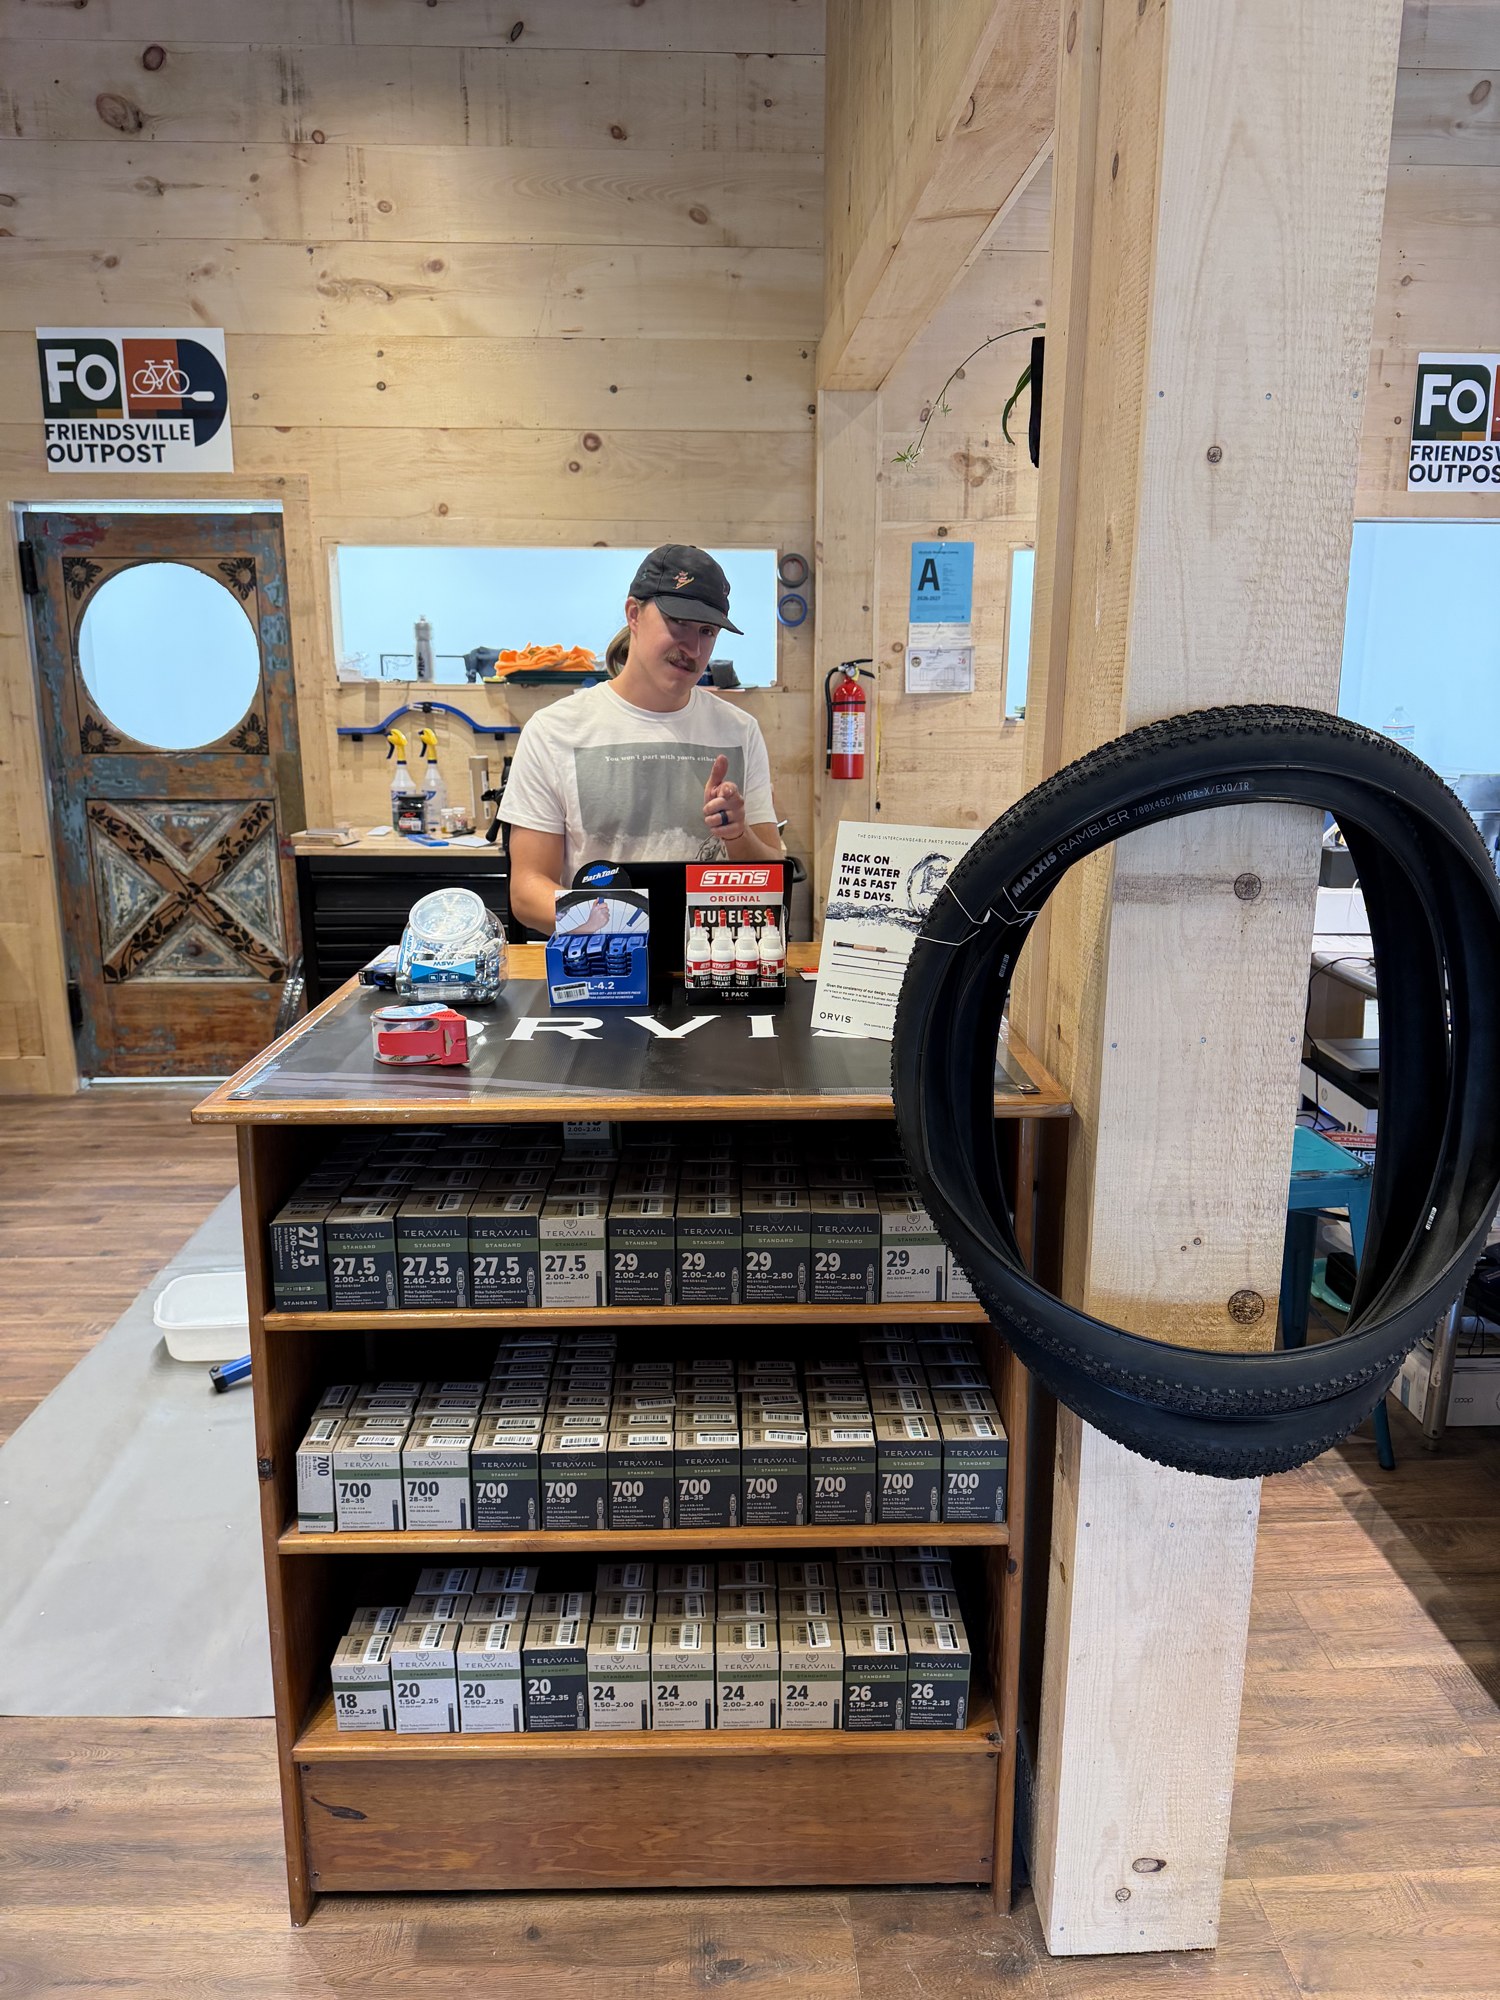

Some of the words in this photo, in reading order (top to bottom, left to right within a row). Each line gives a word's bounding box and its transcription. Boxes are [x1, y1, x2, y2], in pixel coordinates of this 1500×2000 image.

[44, 348, 117, 403] FO
[1419, 374, 1486, 426] FO
[45, 423, 190, 441] FRIENDSVILLE
[47, 443, 166, 463] OUTPOST
[918, 558, 940, 591] A
[882, 835, 927, 843] INTERCHANGEABLE
[842, 853, 870, 864] BACK
[873, 855, 890, 865] ON
[1011, 851, 1057, 898] MAXXIS
[1057, 809, 1130, 856] RAMBLER
[841, 864, 861, 875] THE
[864, 867, 900, 878] WATER
[839, 877, 850, 886] IN
[853, 878, 867, 888] AS
[870, 879, 897, 890] FAST
[837, 888, 851, 897] AS
[854, 889, 860, 898] 5
[864, 891, 894, 902] DAYS.
[587, 982, 615, 990] L-4.2
[819, 1012, 852, 1023] ORVIS
[333, 1232, 384, 1240] TERAVAIL
[474, 1230, 531, 1238] TERAVAIL
[748, 1225, 803, 1233] TERAVAIL
[818, 1225, 872, 1233] TERAVAIL
[289, 1227, 299, 1270] 2.00-2.40
[298, 1226, 319, 1267] 27.5
[333, 1257, 376, 1275] 27.5
[544, 1255, 586, 1272] 27.5
[614, 1253, 638, 1271] 29
[682, 1253, 706, 1270] 29
[746, 1252, 772, 1271] 29
[815, 1253, 841, 1272] 29
[886, 1250, 910, 1267] 29
[402, 1257, 449, 1276] 27.5
[473, 1257, 520, 1276] 27.5
[334, 1275, 379, 1283] 2.00-2.40
[404, 1277, 451, 1285] 2.40-2.80
[474, 1277, 522, 1285] 2.40-2.80
[317, 1456, 329, 1476] 700
[407, 1481, 439, 1496] 700
[612, 1481, 644, 1496] 700
[679, 1479, 710, 1494] 700
[746, 1478, 778, 1493] 700
[815, 1477, 846, 1492] 700
[882, 1474, 914, 1489] 700
[948, 1474, 979, 1489] 700
[339, 1483, 371, 1497] 700
[476, 1483, 508, 1498] 700
[545, 1482, 578, 1498] 700
[398, 1683, 420, 1698] 20
[463, 1684, 486, 1698] 20
[528, 1679, 551, 1694] 20
[593, 1686, 615, 1700] 24
[657, 1685, 680, 1700] 24
[723, 1686, 745, 1700] 24
[786, 1685, 809, 1700] 24
[849, 1685, 872, 1701] 26
[911, 1683, 934, 1699] 26
[337, 1694, 357, 1708] 18
